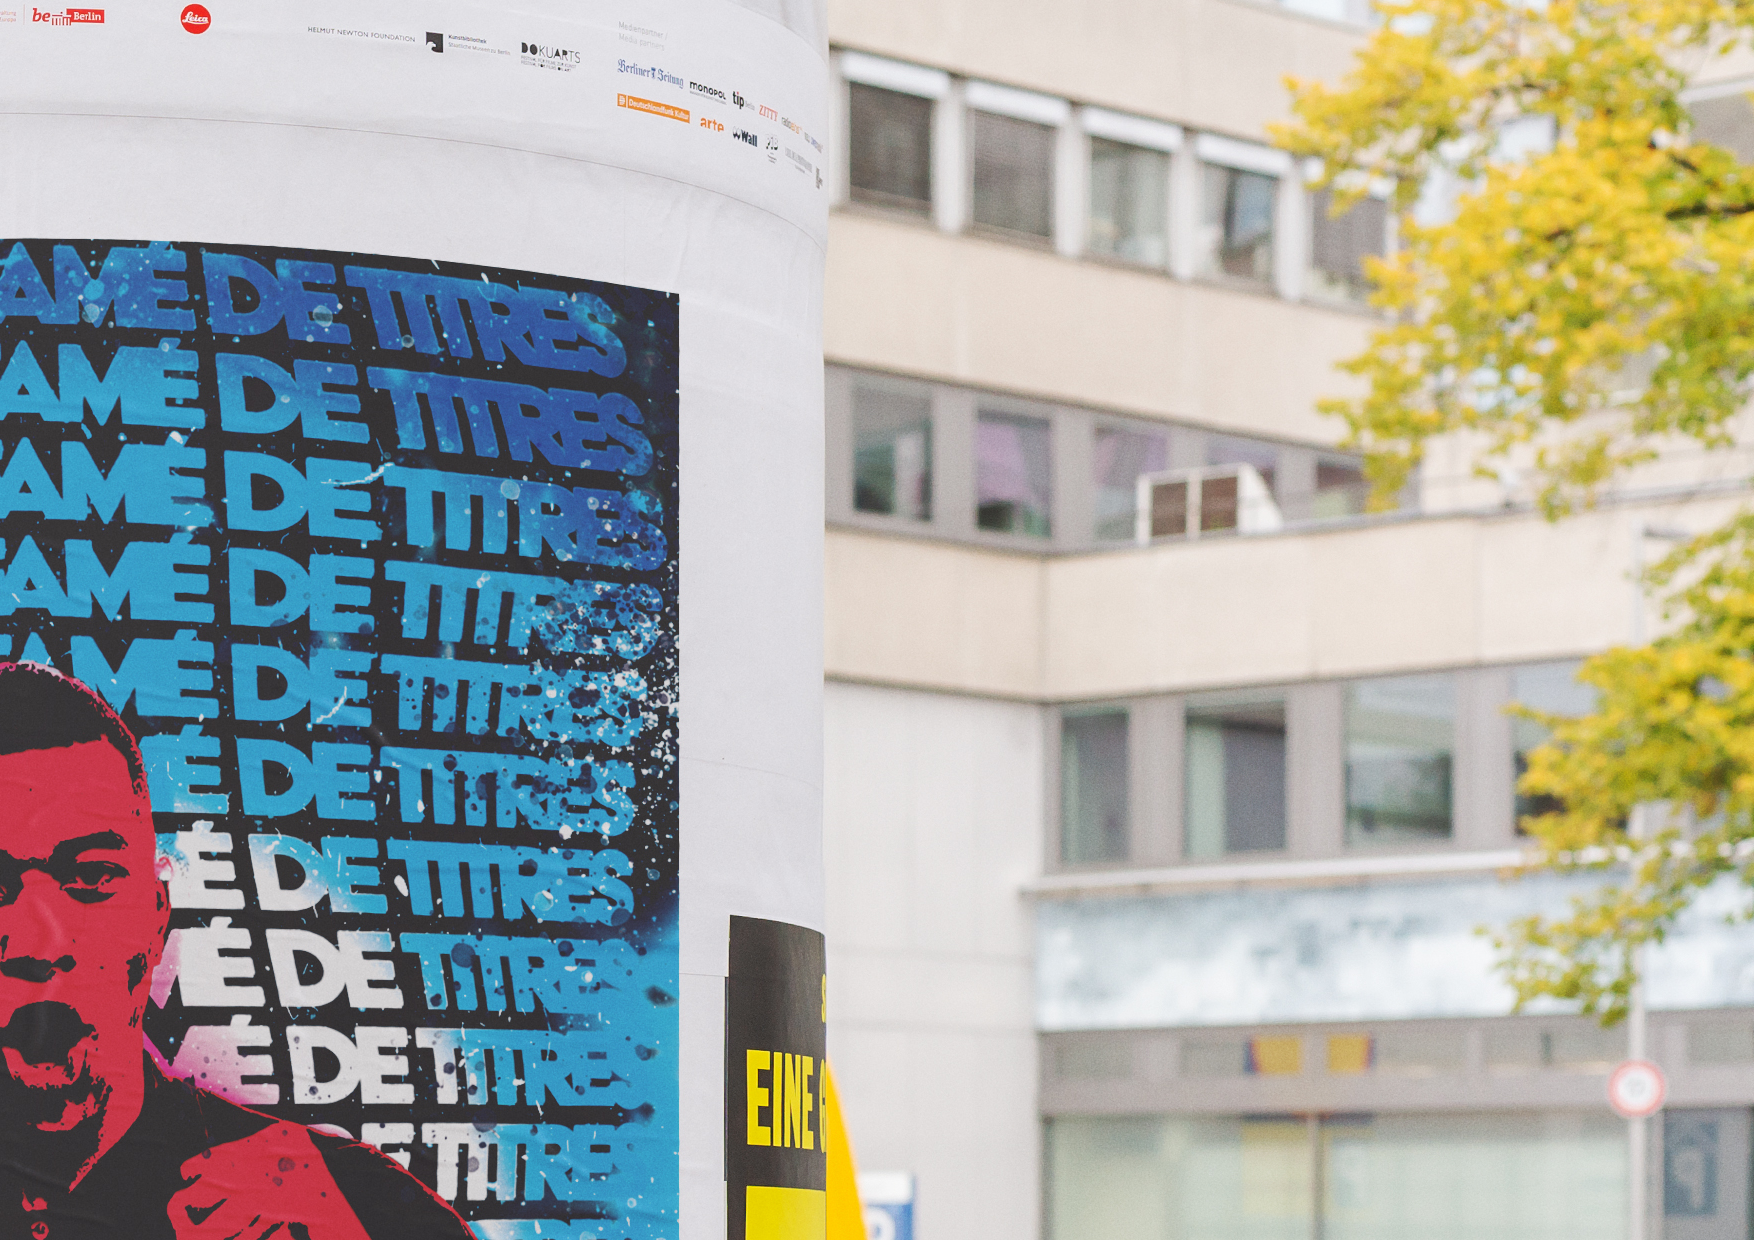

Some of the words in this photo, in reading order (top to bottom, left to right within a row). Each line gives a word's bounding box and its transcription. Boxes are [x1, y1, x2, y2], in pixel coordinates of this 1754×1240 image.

[72, 11, 103, 22] Berlin
[182, 11, 210, 25] Leica
[307, 26, 336, 36] HELMUT
[336, 29, 369, 40] NEWTON
[370, 32, 416, 43] FOUNDATION
[521, 42, 582, 64] DOKUARTS
[617, 59, 651, 78] Berliner
[732, 91, 745, 110] tip
[699, 117, 725, 133] arte
[202, 251, 353, 345] DE
[344, 264, 628, 378] TITRES
[215, 352, 371, 445] DE
[367, 366, 654, 477] TITRES
[223, 449, 384, 544] DE
[383, 463, 668, 572] TITRES
[228, 546, 377, 635] DE
[231, 640, 378, 727] DE
[236, 735, 379, 822] DE
[248, 832, 389, 914] DE
[386, 837, 635, 927] TITRES
[265, 928, 405, 1010] DE
[286, 1025, 416, 1107] DE
[746, 1048, 815, 1151] EINE
